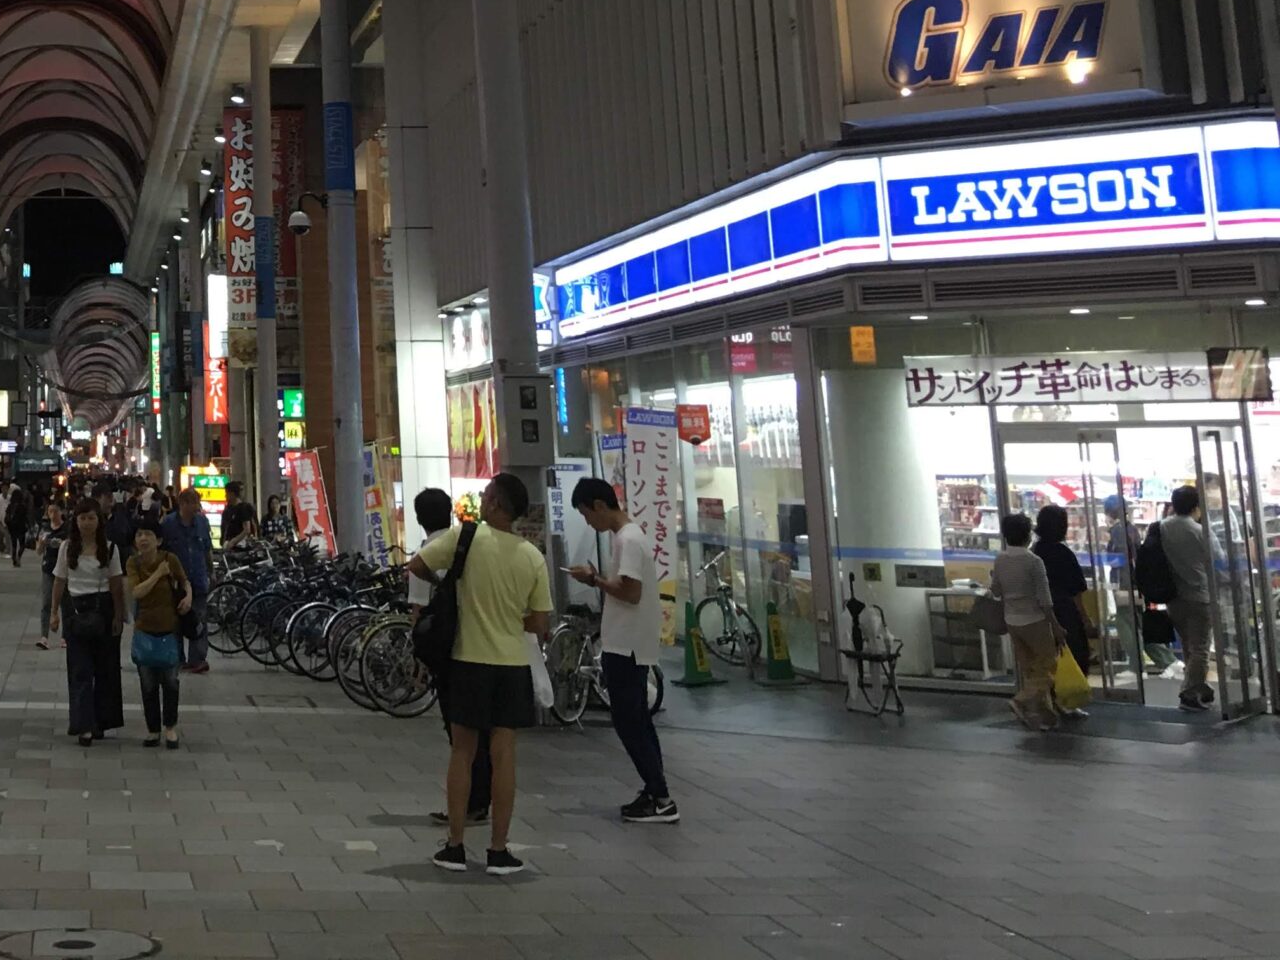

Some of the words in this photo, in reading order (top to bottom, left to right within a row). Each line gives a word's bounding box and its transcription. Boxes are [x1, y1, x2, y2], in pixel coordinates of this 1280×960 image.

[910, 165, 1177, 226] LAWSON
[905, 358, 1209, 405] サンドイッチ革命はじまる。
[627, 411, 675, 426] LAWSON
